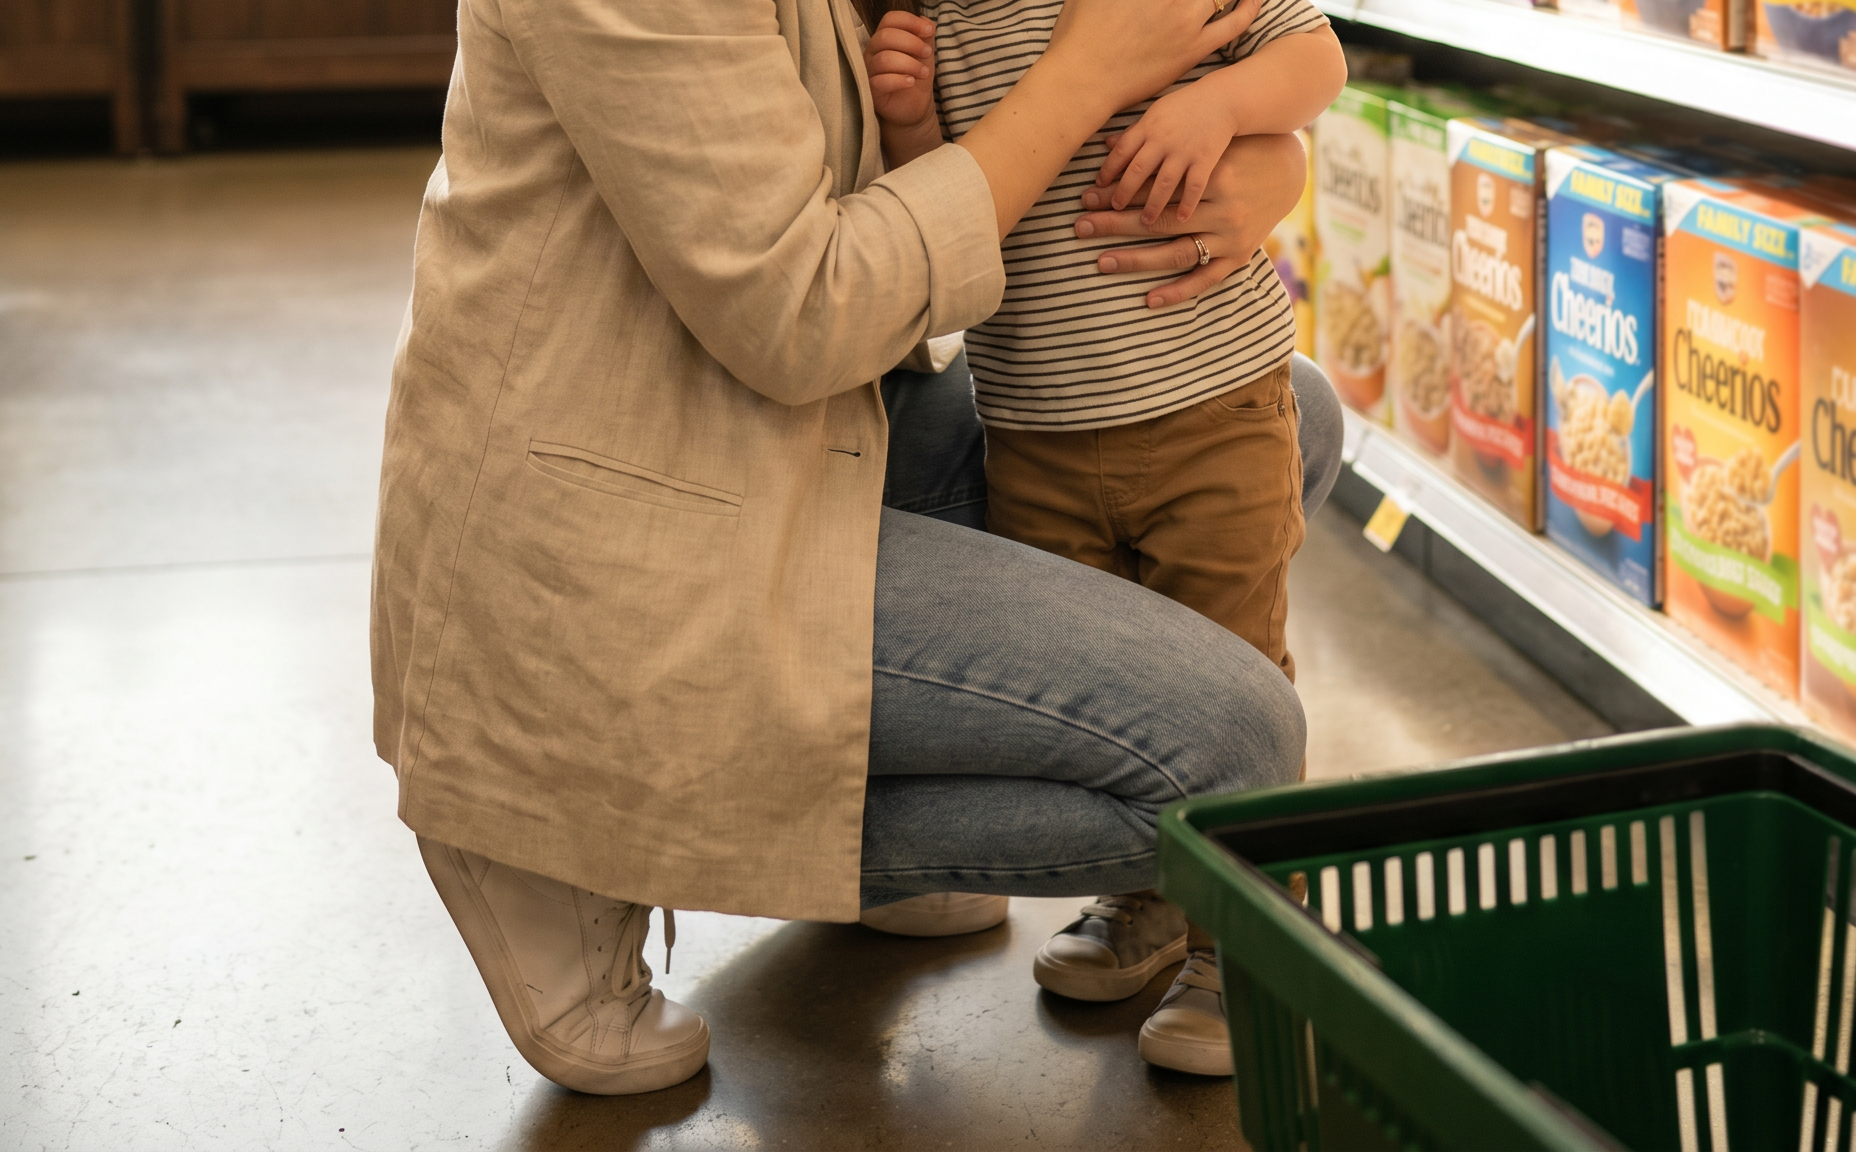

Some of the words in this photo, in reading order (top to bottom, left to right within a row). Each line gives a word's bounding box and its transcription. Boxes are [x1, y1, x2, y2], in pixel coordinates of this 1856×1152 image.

[1697, 203, 1752, 244] FAMILY
[1452, 228, 1524, 312] Cheerios
[1551, 270, 1639, 366] Cheerios
[1673, 327, 1783, 435] Cheerios
